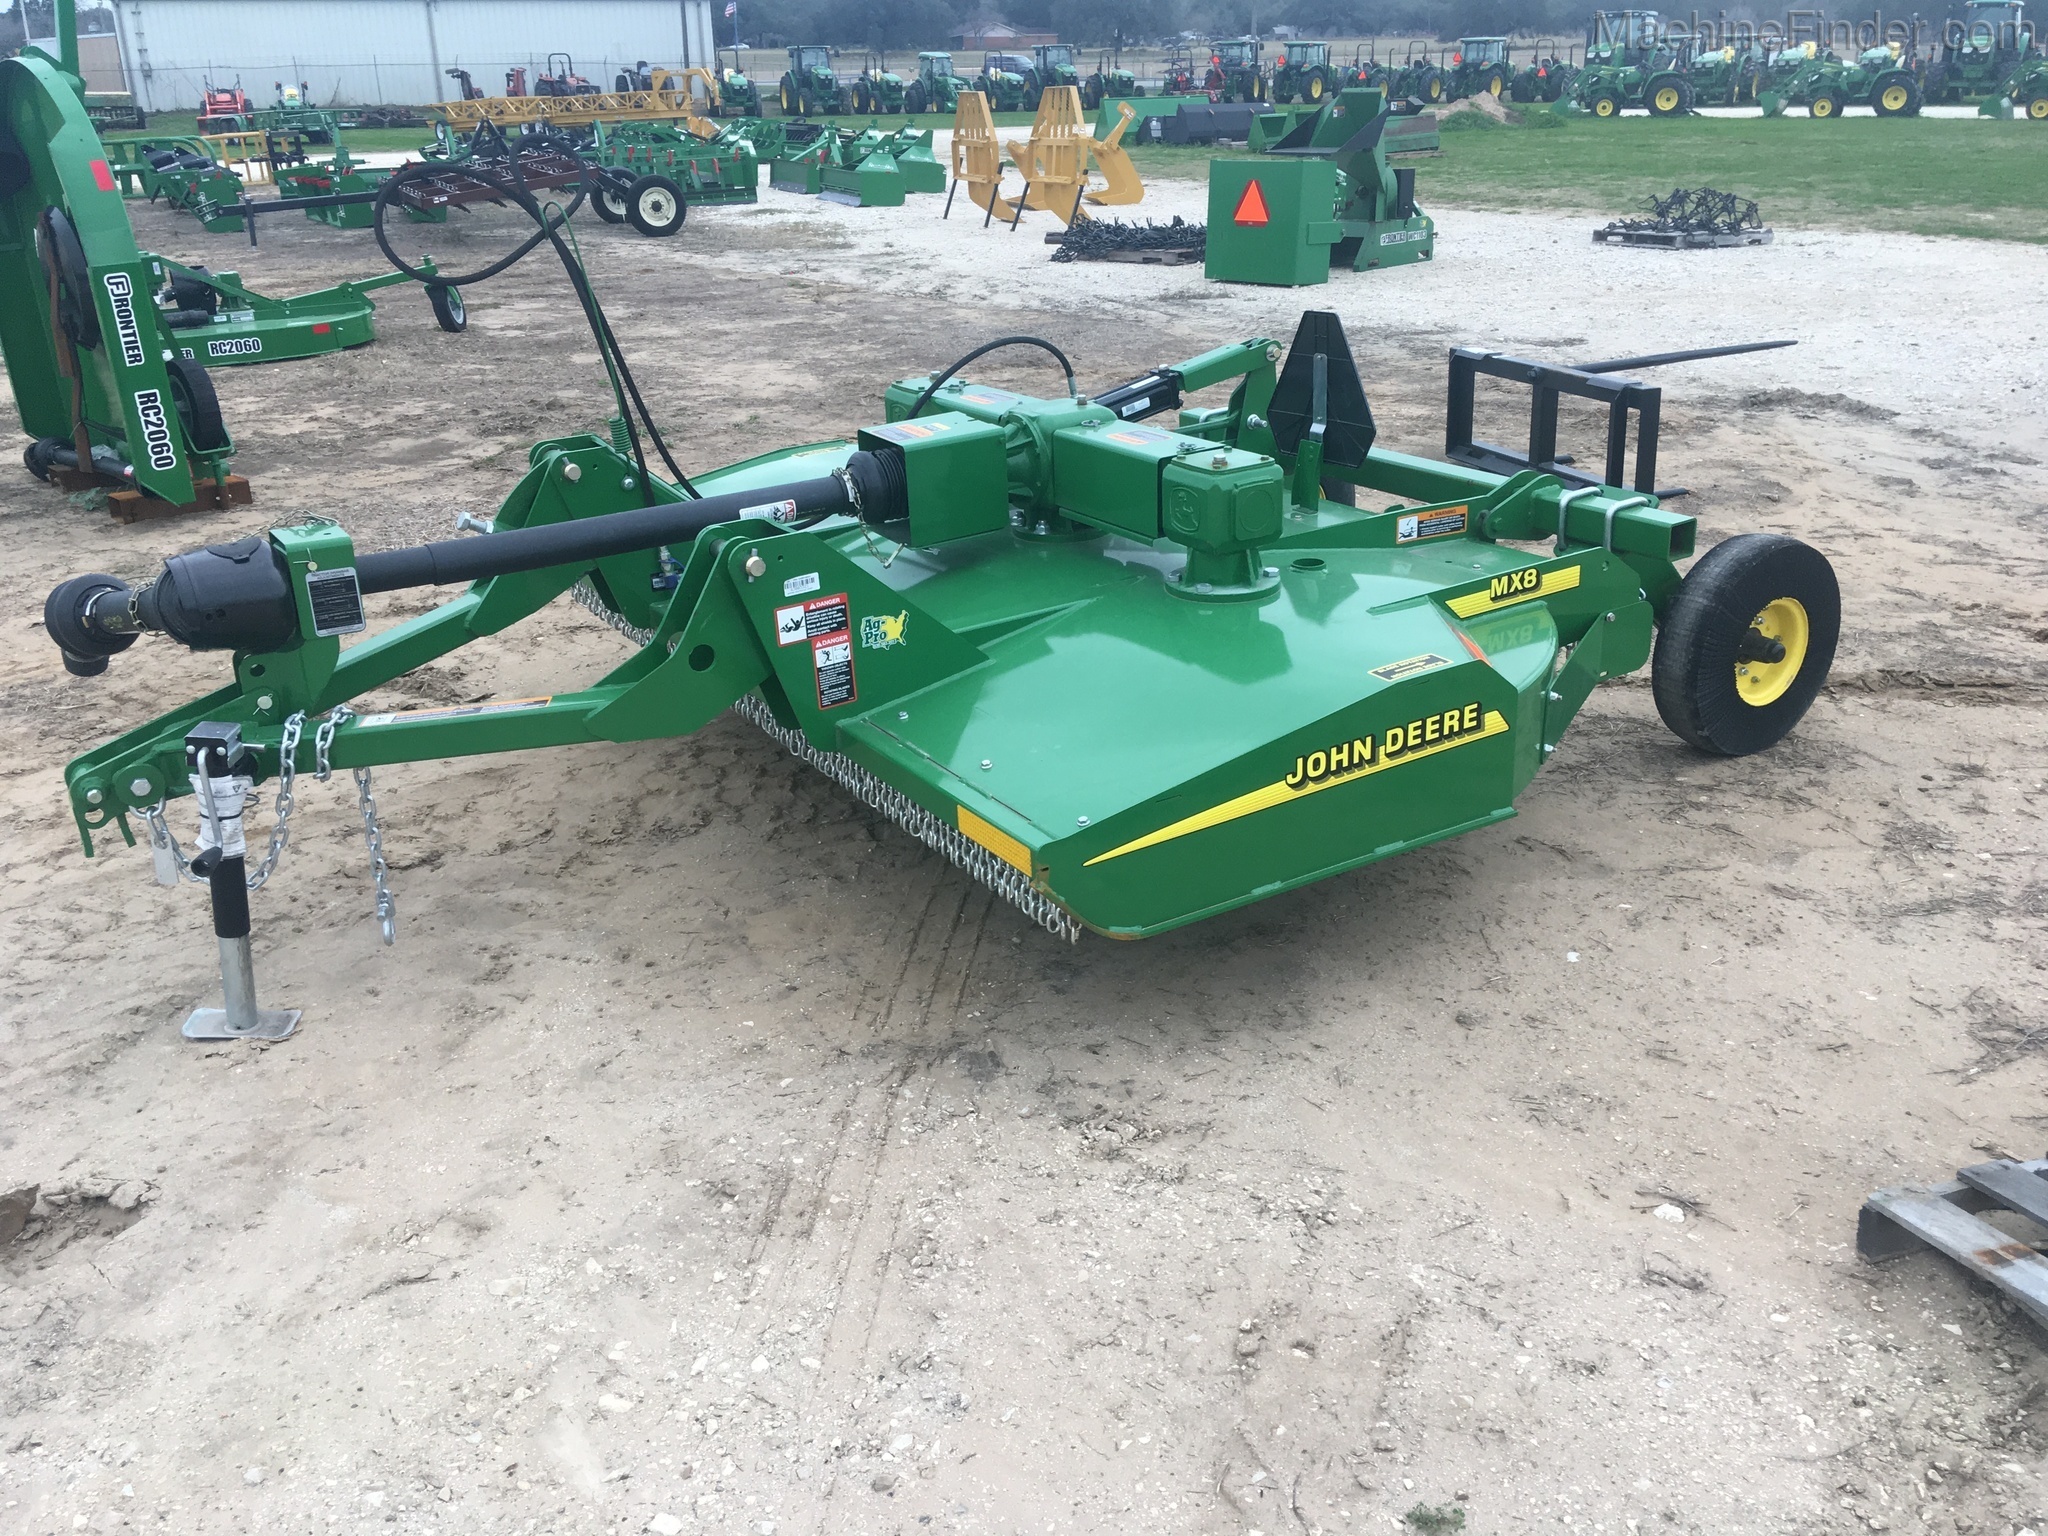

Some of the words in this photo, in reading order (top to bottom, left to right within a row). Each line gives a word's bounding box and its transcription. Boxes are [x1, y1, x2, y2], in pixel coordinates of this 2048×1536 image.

[105, 273, 144, 366] FRONTIER
[208, 338, 262, 356] RC2060
[136, 390, 175, 469] RC2060
[1489, 567, 1539, 600] MX8
[816, 597, 841, 608] DANGER
[864, 618, 886, 632] Ag-
[822, 634, 848, 646] DANGER
[864, 631, 887, 645] Pro
[1285, 735, 1374, 786] JOHN
[1384, 701, 1480, 756] DEERE
